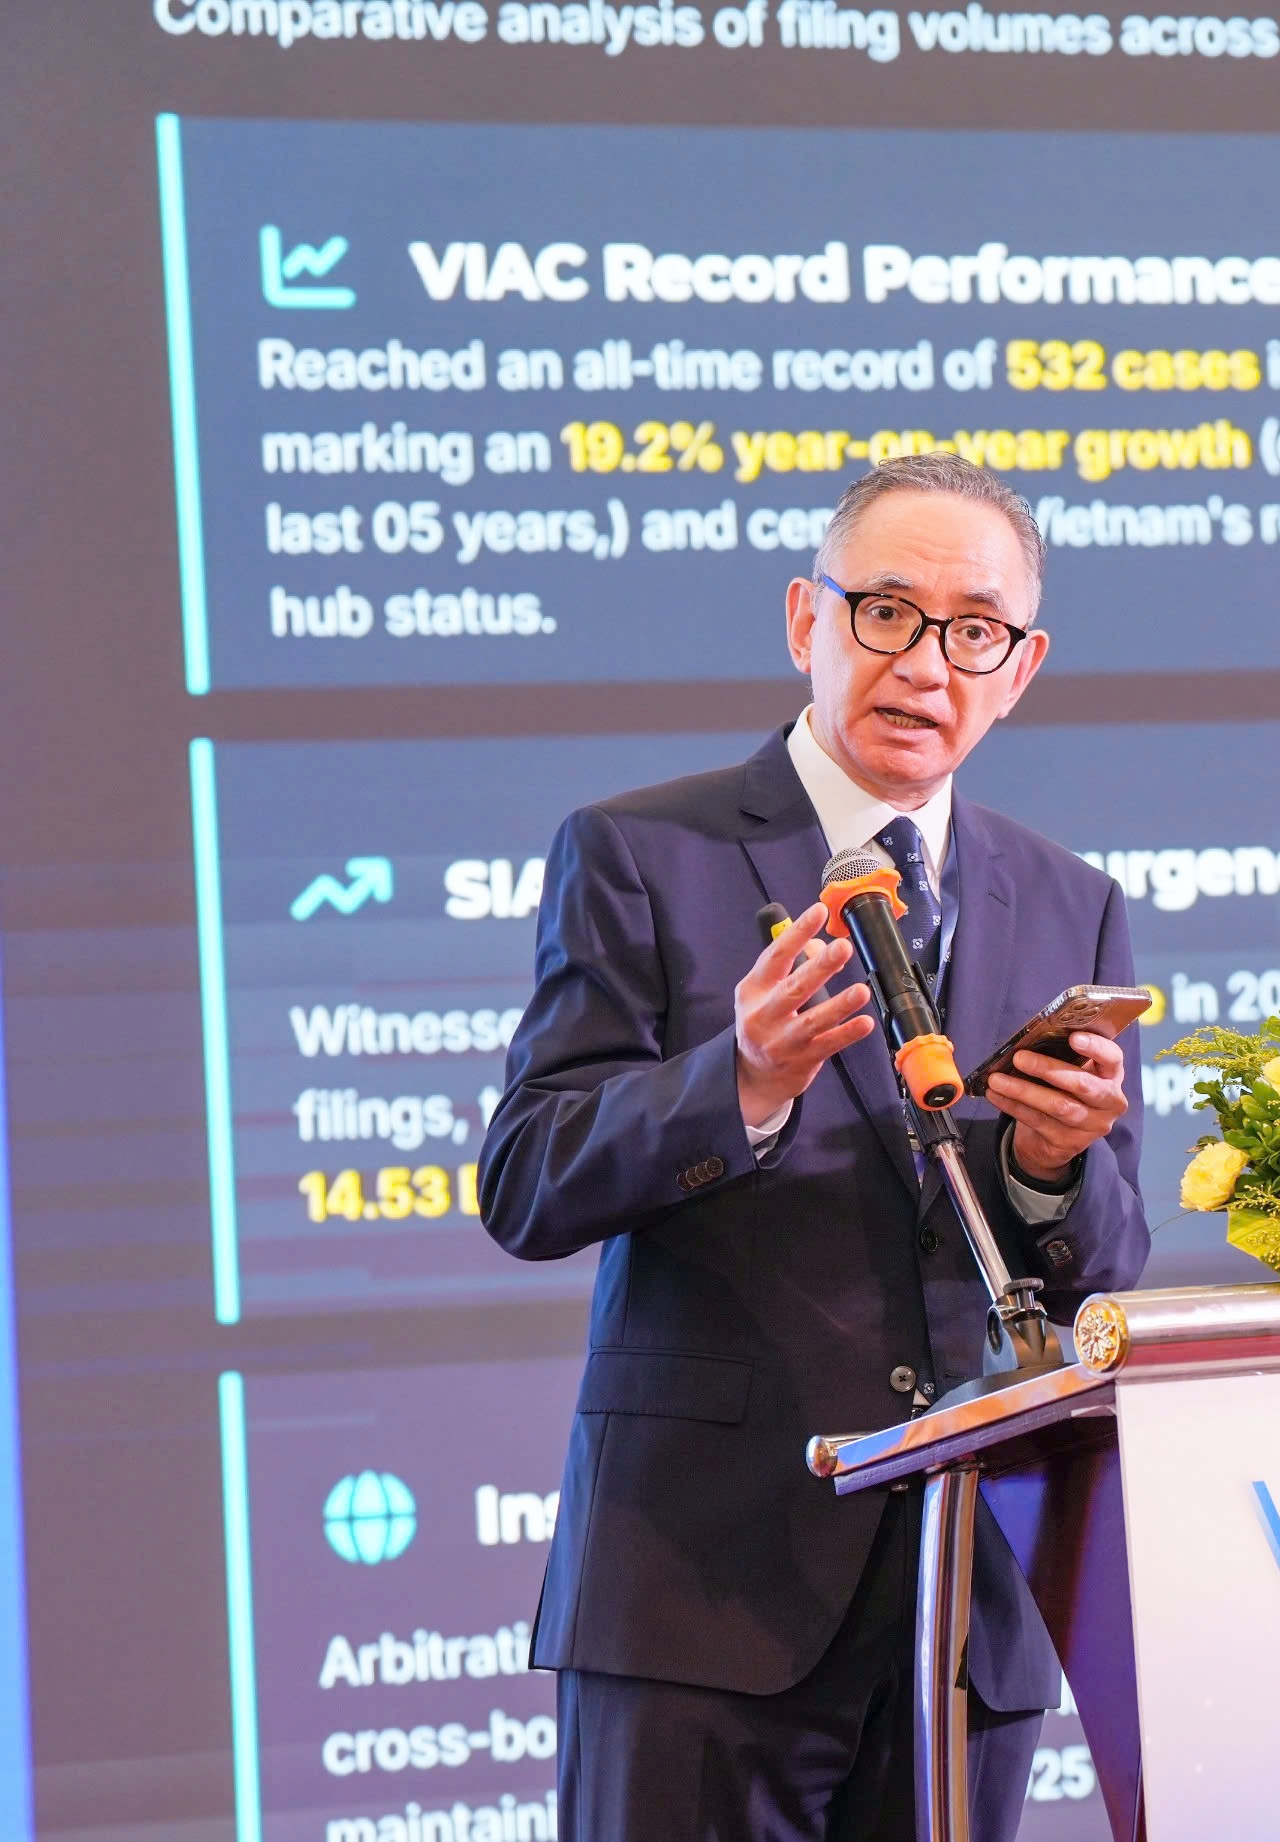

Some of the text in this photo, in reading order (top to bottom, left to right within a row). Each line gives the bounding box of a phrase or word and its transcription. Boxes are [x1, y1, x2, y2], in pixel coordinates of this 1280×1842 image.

[154, 0, 488, 48] Comparative
[498, 0, 704, 55] analysis
[713, 0, 767, 47] of
[777, 4, 900, 62] filing
[911, 7, 1113, 56] volumes
[1120, 16, 1280, 57] across
[408, 241, 588, 301] VIAC
[603, 241, 850, 302] Record
[258, 338, 485, 390] Reached
[497, 349, 563, 390] an
[574, 339, 762, 391] all-time
[773, 340, 934, 390] record
[943, 338, 996, 390] of
[1007, 340, 1106, 390] 532
[1112, 351, 1260, 390] cases
[262, 422, 474, 485] marking
[485, 432, 551, 473] an
[561, 421, 723, 472] 19.2%
[732, 430, 1069, 482] year-on-year
[1075, 420, 1250, 481] growth
[266, 503, 363, 554] last
[373, 501, 443, 553] 05
[453, 499, 629, 563] years,)
[642, 500, 737, 551] and
[270, 586, 556, 637] hub status.
[1172, 973, 1219, 1023] in
[294, 1089, 468, 1150] filings,
[299, 1166, 450, 1222] 14.53
[323, 1708, 1095, 1801] cross-bo 25
